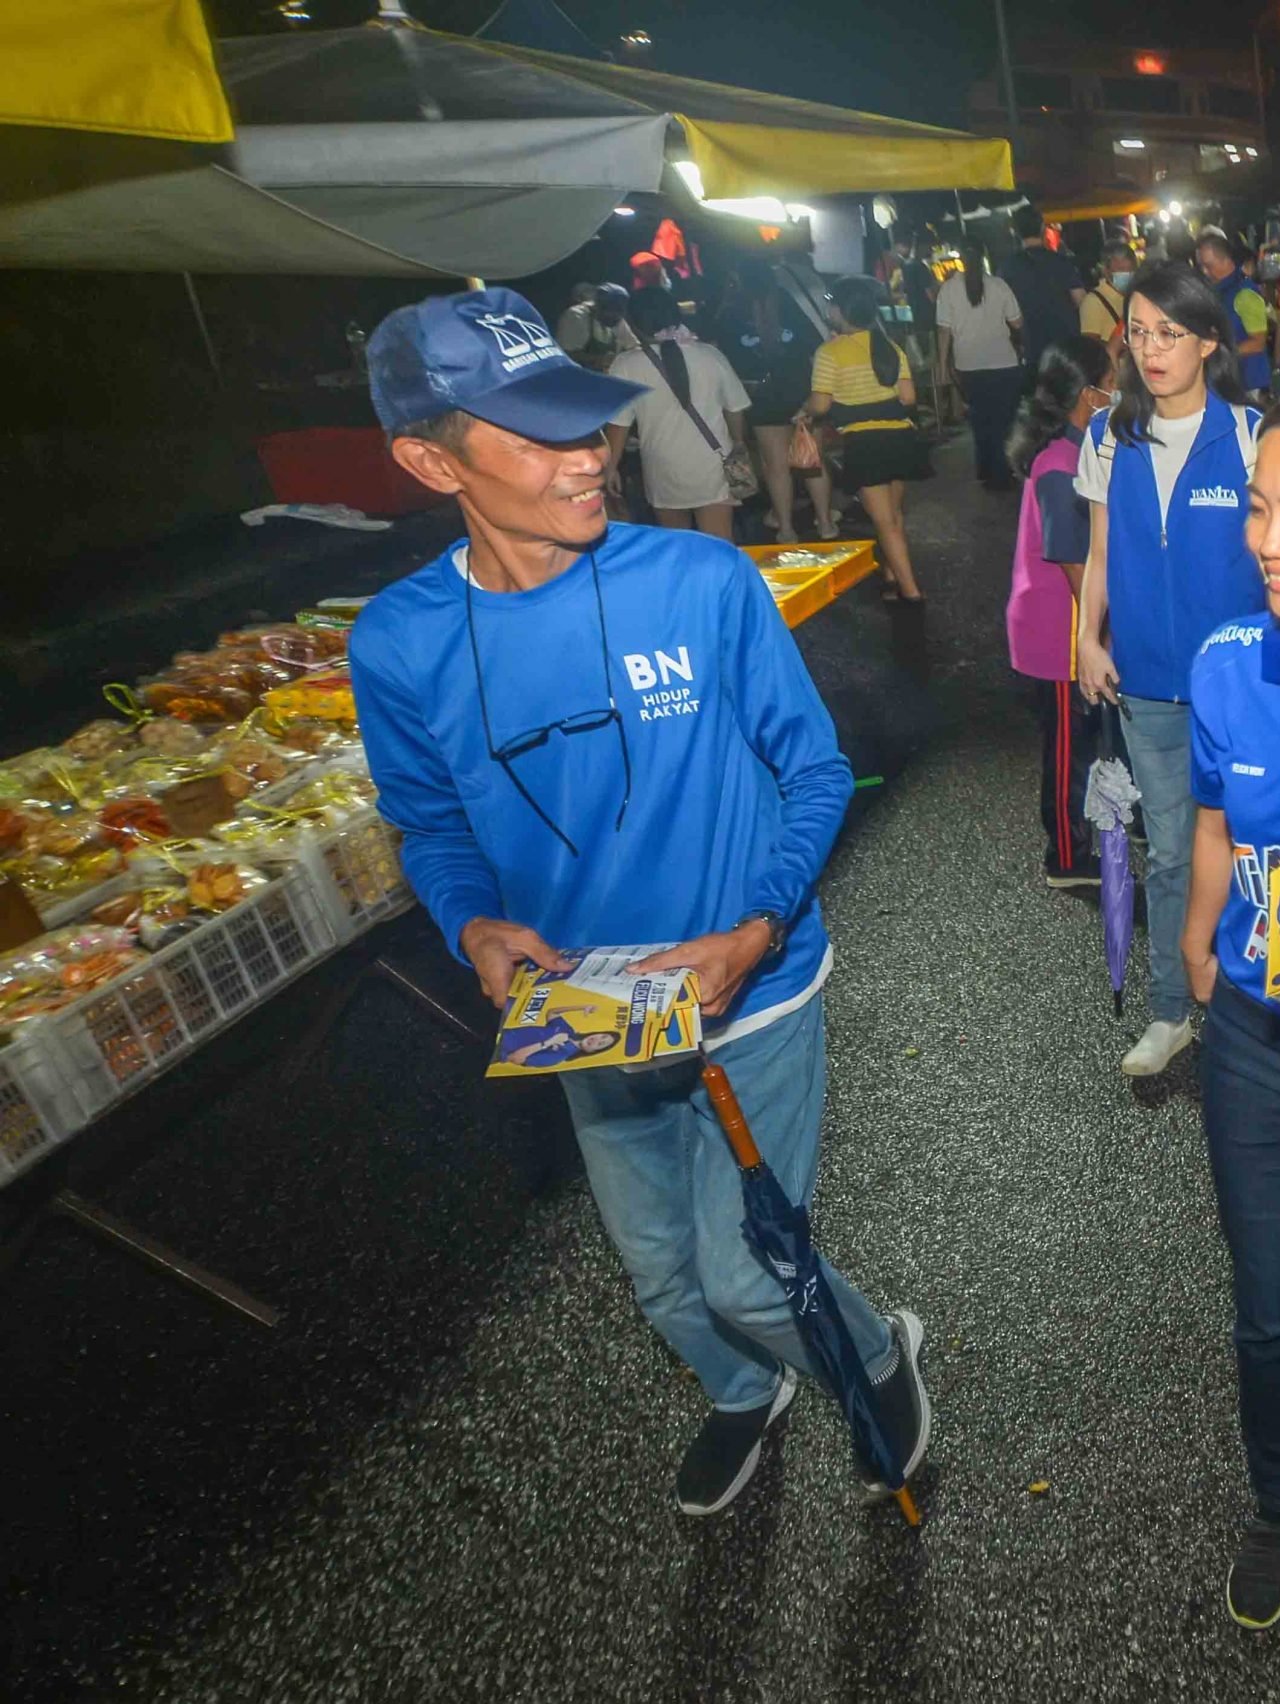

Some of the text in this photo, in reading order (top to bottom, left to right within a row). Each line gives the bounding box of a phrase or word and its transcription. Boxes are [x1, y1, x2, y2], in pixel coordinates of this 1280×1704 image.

[623, 646, 694, 691] BN
[642, 688, 691, 707] HIDUP
[639, 700, 700, 722] RAKYAT
[630, 1002, 647, 1025] WONG
